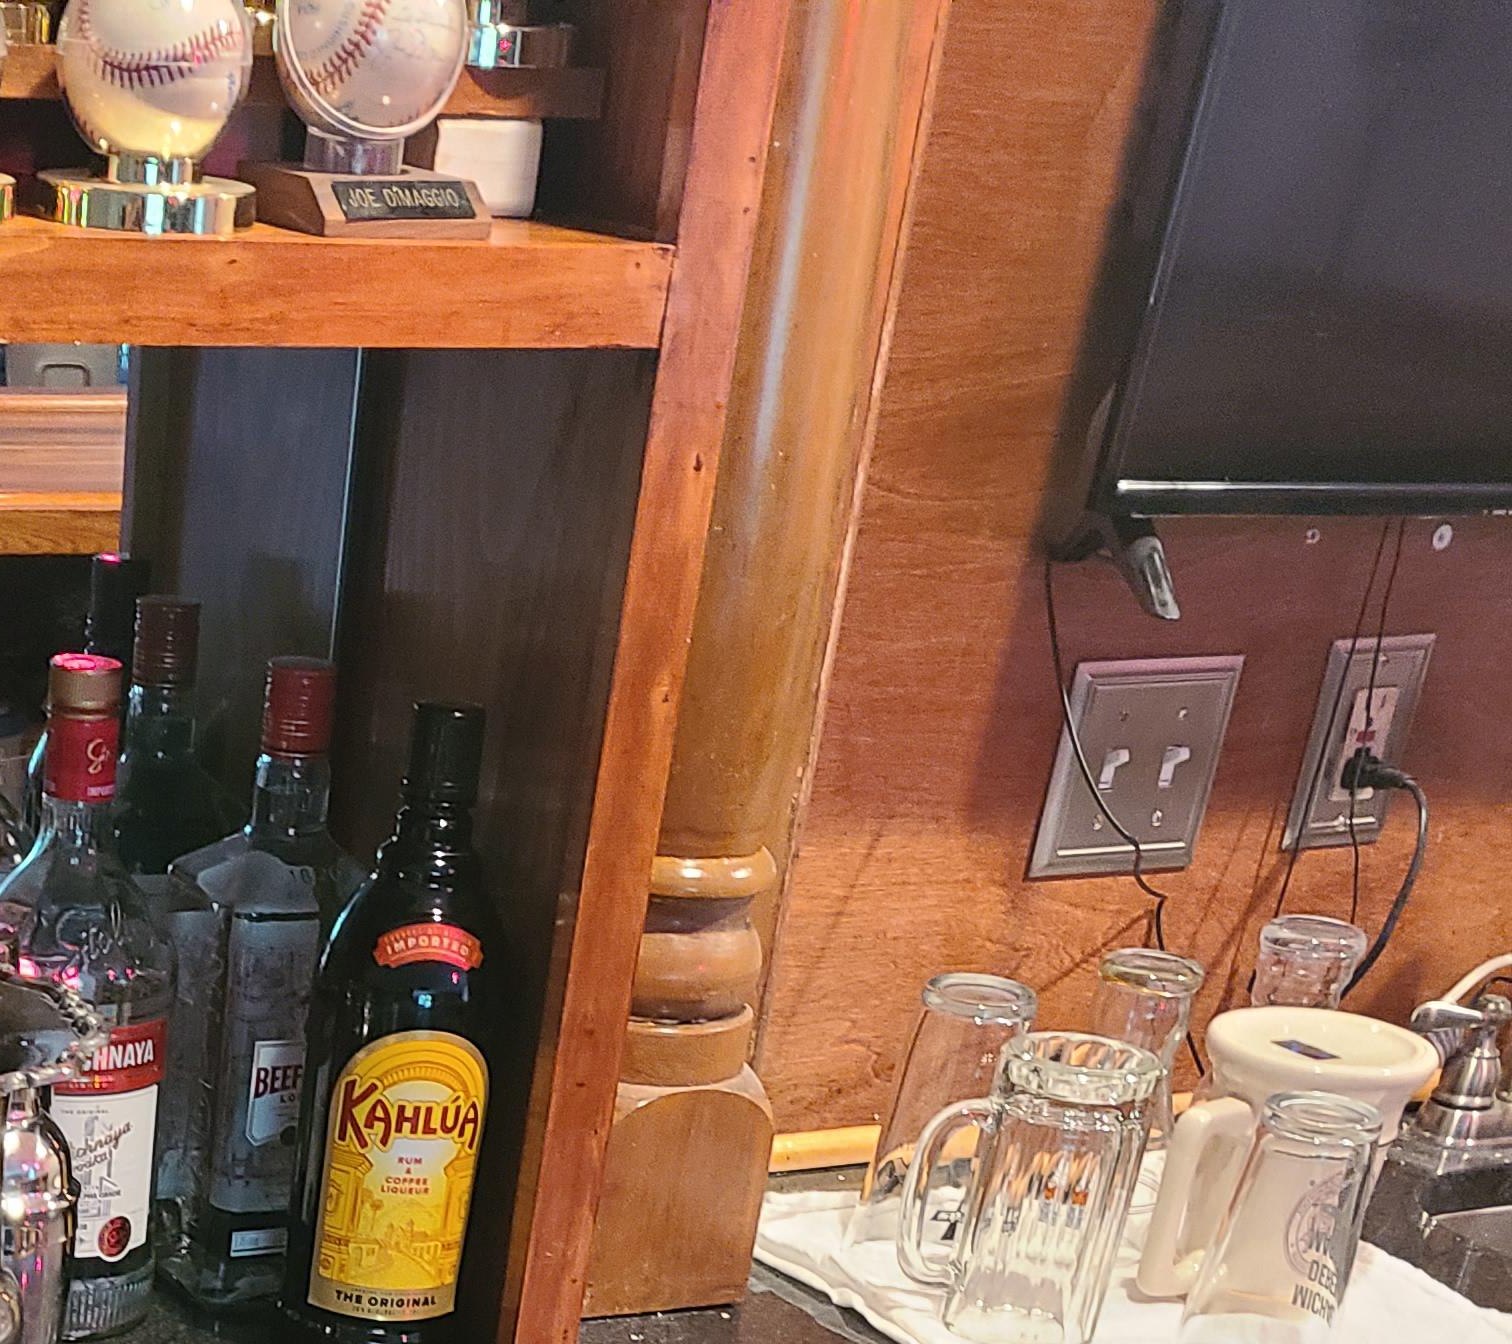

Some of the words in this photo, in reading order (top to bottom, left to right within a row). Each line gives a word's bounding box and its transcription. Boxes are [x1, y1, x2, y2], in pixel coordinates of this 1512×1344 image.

[348, 188, 382, 208] JOE
[387, 934, 470, 957] IMPORTED
[254, 1063, 303, 1098] BEEF
[338, 1078, 479, 1151] KAHLÚA
[397, 1156, 423, 1166] RUM
[380, 1184, 430, 1196] LIQUEUR
[385, 1176, 429, 1186] COFFEE
[335, 1289, 363, 1305] THE
[368, 1296, 437, 1309] ORIGINAL
